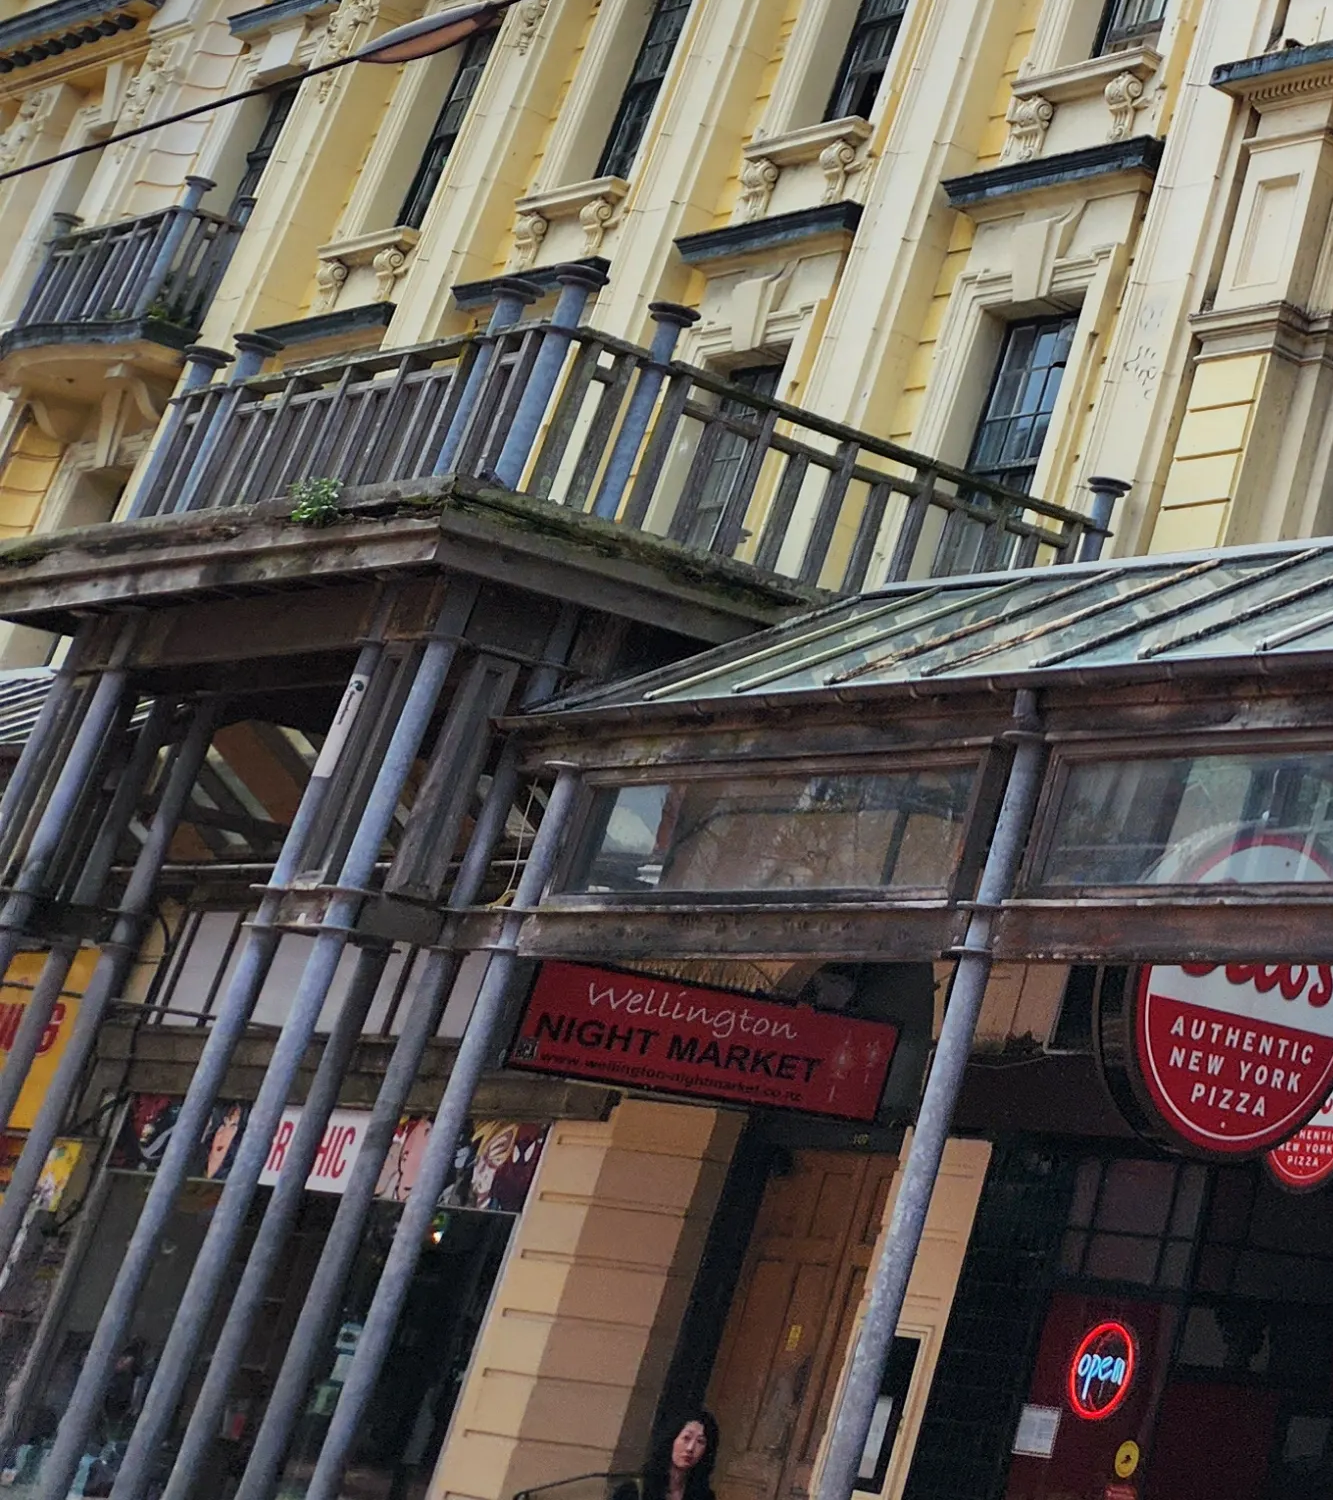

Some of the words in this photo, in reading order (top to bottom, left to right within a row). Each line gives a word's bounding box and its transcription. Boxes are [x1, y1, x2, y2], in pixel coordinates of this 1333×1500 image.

[587, 981, 798, 1040] Wellington
[533, 1011, 661, 1056] NIGHT
[665, 1033, 823, 1084] MARKET
[1170, 1015, 1315, 1066] AUTHENTIC
[1168, 1046, 1225, 1076] NEW
[1238, 1060, 1302, 1094] YORK
[1190, 1083, 1266, 1118] PIZZA
[1287, 1155, 1320, 1167] PIZZA
[1077, 1353, 1126, 1400] open
